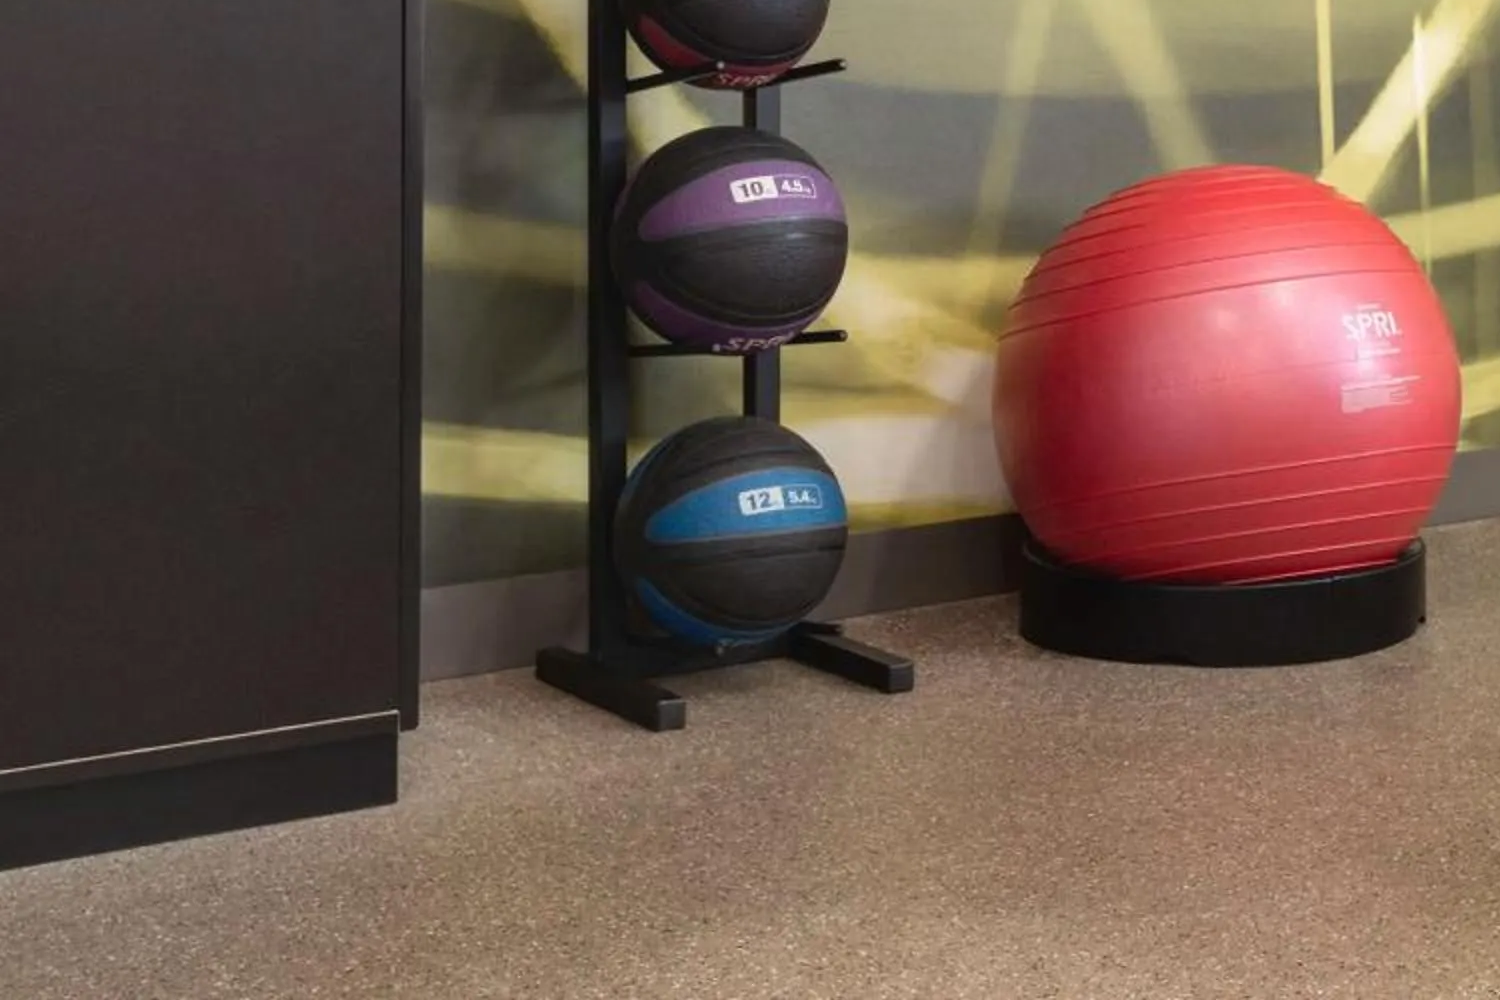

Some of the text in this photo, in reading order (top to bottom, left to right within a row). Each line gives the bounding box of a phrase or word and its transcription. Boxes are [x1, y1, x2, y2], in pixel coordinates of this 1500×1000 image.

[738, 181, 764, 198] 10
[1341, 310, 1398, 341] SPRI
[746, 491, 771, 511] 12
